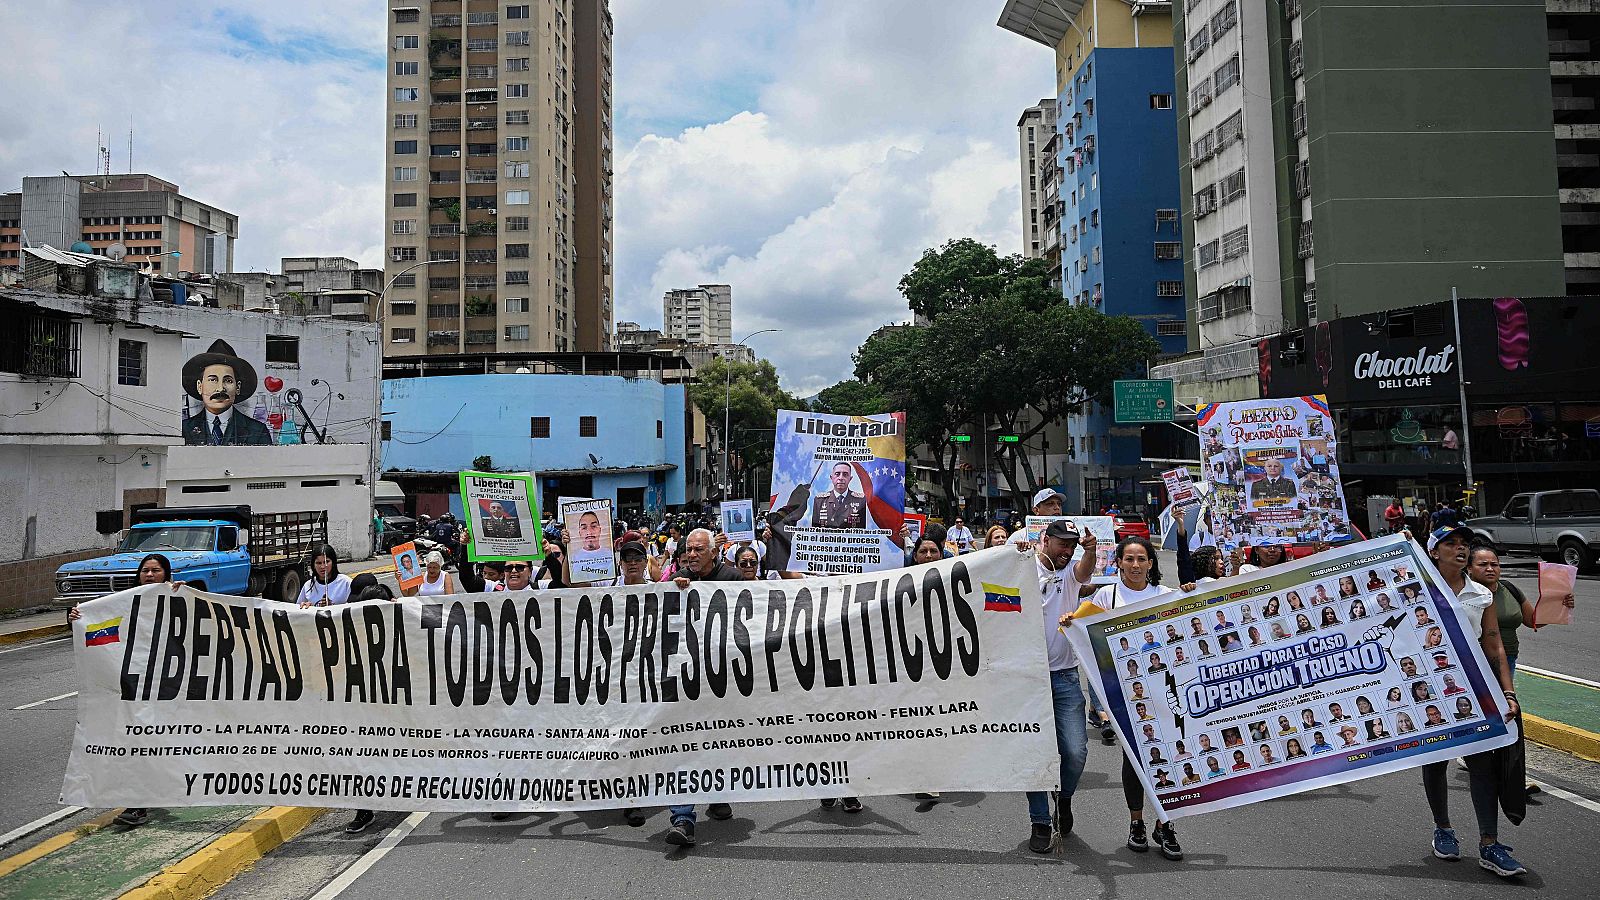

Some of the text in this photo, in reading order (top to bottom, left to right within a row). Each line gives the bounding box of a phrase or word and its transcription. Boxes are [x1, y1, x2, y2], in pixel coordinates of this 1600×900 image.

[1354, 344, 1455, 379] Chocolat
[1379, 376, 1432, 389] DELI CAFÉ
[1227, 405, 1297, 428] LIBERTAD
[795, 418, 896, 437] Libertad
[822, 437, 867, 447] EXPEDIENTE
[473, 477, 515, 489] Libertad
[796, 543, 807, 551] Sin
[842, 546, 880, 554] expediente
[810, 534, 818, 542] el
[819, 535, 846, 543] debido
[847, 537, 880, 545] proceso
[796, 552, 881, 564] Sin respuesta del TSJ
[808, 562, 863, 574] Sin Justicia
[1310, 566, 1341, 578] TRIBUNAL
[1390, 548, 1404, 557] NAC
[581, 565, 609, 575] Libertad
[120, 561, 980, 707] LIBERTAD PARA TODOS LOS PRESOS POLITICOS
[1200, 634, 1346, 683] LIBERTAD PARA EL CASO
[1187, 643, 1384, 716] OPERACIÓN TRUENO
[1206, 715, 1237, 727] DETENIDOS
[1237, 706, 1278, 721] INJUSTAMENTE
[1296, 697, 1313, 706] ABRIL
[1335, 679, 1382, 695] GUARICO-APURE
[1257, 701, 1278, 710] UNIDOS
[126, 725, 202, 735] TOCUYITO
[216, 725, 232, 733] LA
[237, 725, 290, 734] PLANTA
[302, 725, 347, 735] RODEO
[359, 726, 395, 736] RAMO
[400, 728, 441, 738] VERDE
[454, 729, 470, 738] LA
[474, 729, 534, 738] YAGUARA
[545, 729, 583, 738] SANTA
[587, 729, 609, 738] ANA
[619, 729, 647, 738] INOF
[661, 719, 745, 735] CRISALIDAS
[757, 715, 794, 726] YARE
[806, 710, 877, 722] TOCORON
[890, 706, 935, 718] FENIX
[939, 701, 979, 714] LARA
[86, 745, 126, 756] CENTRO
[131, 746, 238, 756] PENITENCIARIO
[242, 746, 257, 754] 26
[261, 746, 277, 754] DE
[284, 747, 324, 757] JUNIO,
[329, 747, 353, 756] SAN
[357, 748, 388, 757] JUAN
[393, 749, 408, 757] DE
[412, 749, 434, 757] LOS
[439, 750, 488, 758] MORROS
[499, 751, 543, 759] FUERTE
[547, 751, 619, 760] GUAICAIPURO
[630, 745, 679, 759] MINIMA
[682, 743, 698, 752] DE
[702, 738, 773, 750] CARABOBO
[785, 733, 851, 744] COMANDO
[855, 728, 947, 741] ANTIDROGAS,
[951, 724, 977, 735] LAS
[982, 723, 1040, 733] ACACIAS
[185, 761, 849, 801] Y TODOS LOS CENTROS DE RECLUSIÓN DONDE TENGAN PRESOS POLITICOS!!!
